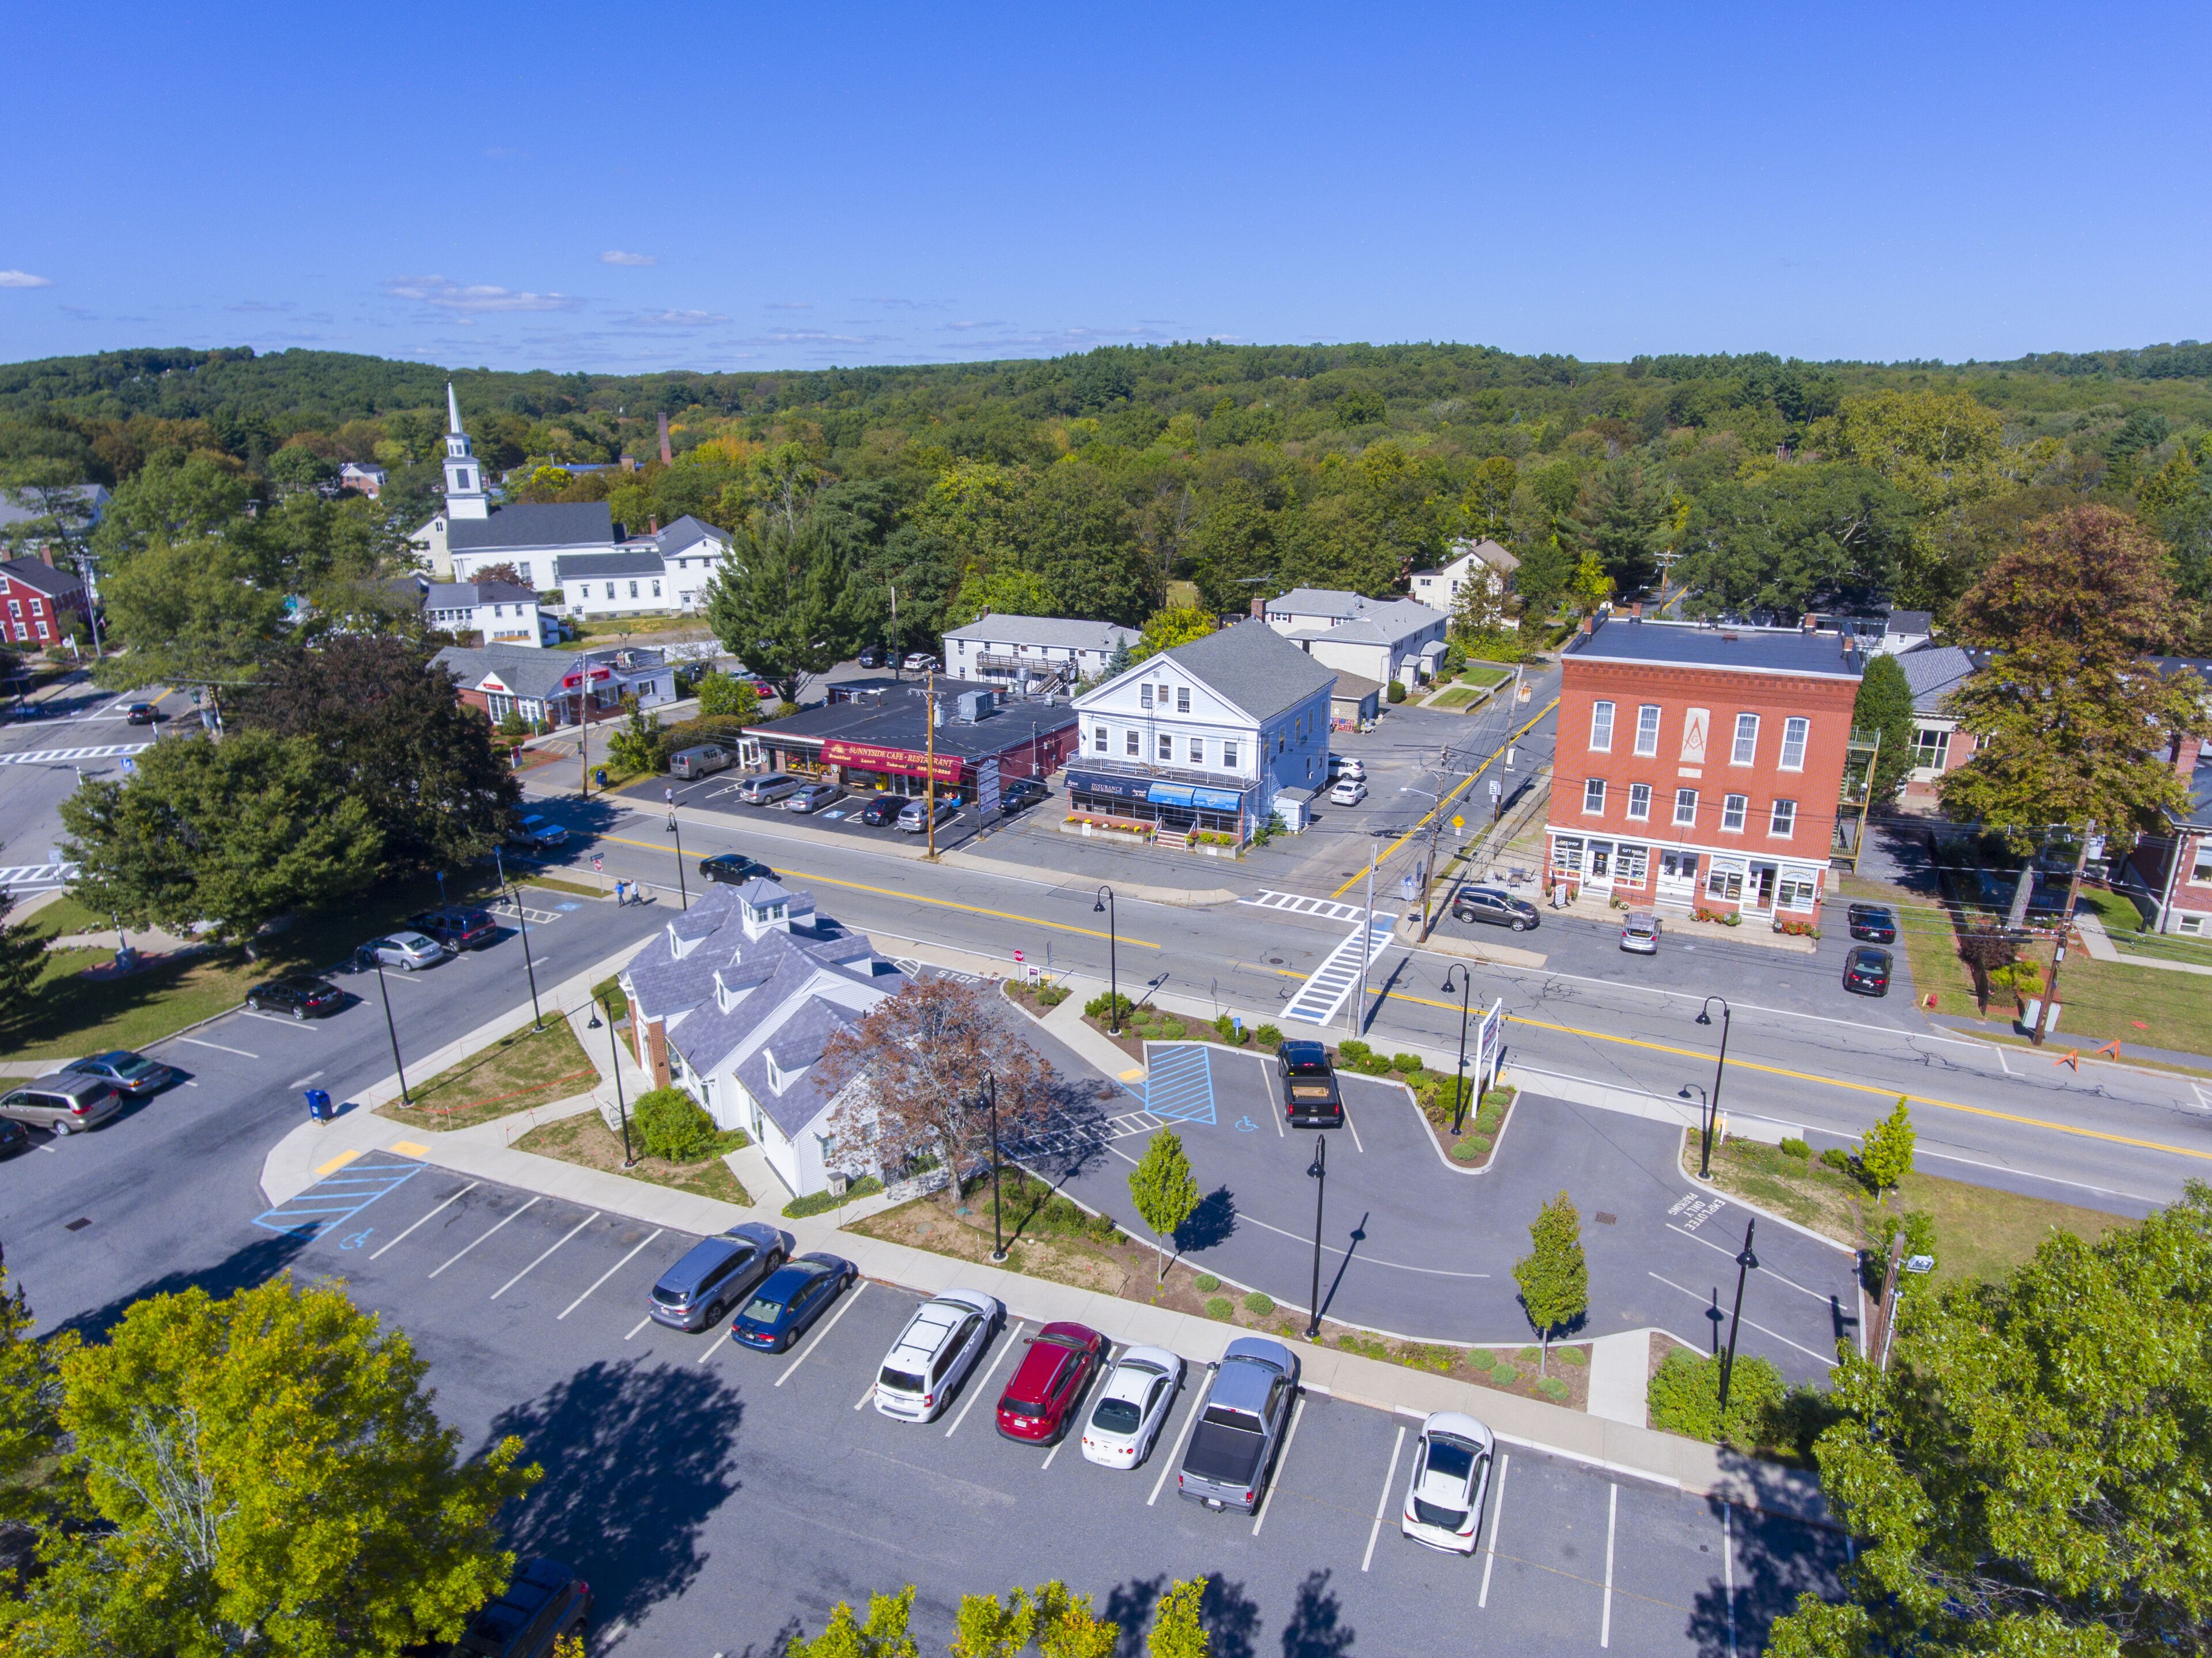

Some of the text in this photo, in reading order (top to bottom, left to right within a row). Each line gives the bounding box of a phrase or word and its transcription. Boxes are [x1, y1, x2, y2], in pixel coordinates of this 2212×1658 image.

[849, 746, 953, 767] SUNNYSIDE CAFE RESTARANT
[1091, 783, 1123, 792] INSURANCE
[935, 970, 981, 984] STOP
[1668, 1192, 1699, 1216] PARKING
[1683, 1201, 1706, 1218] ONLY
[1684, 1198, 1726, 1231] EMPLOYEE
